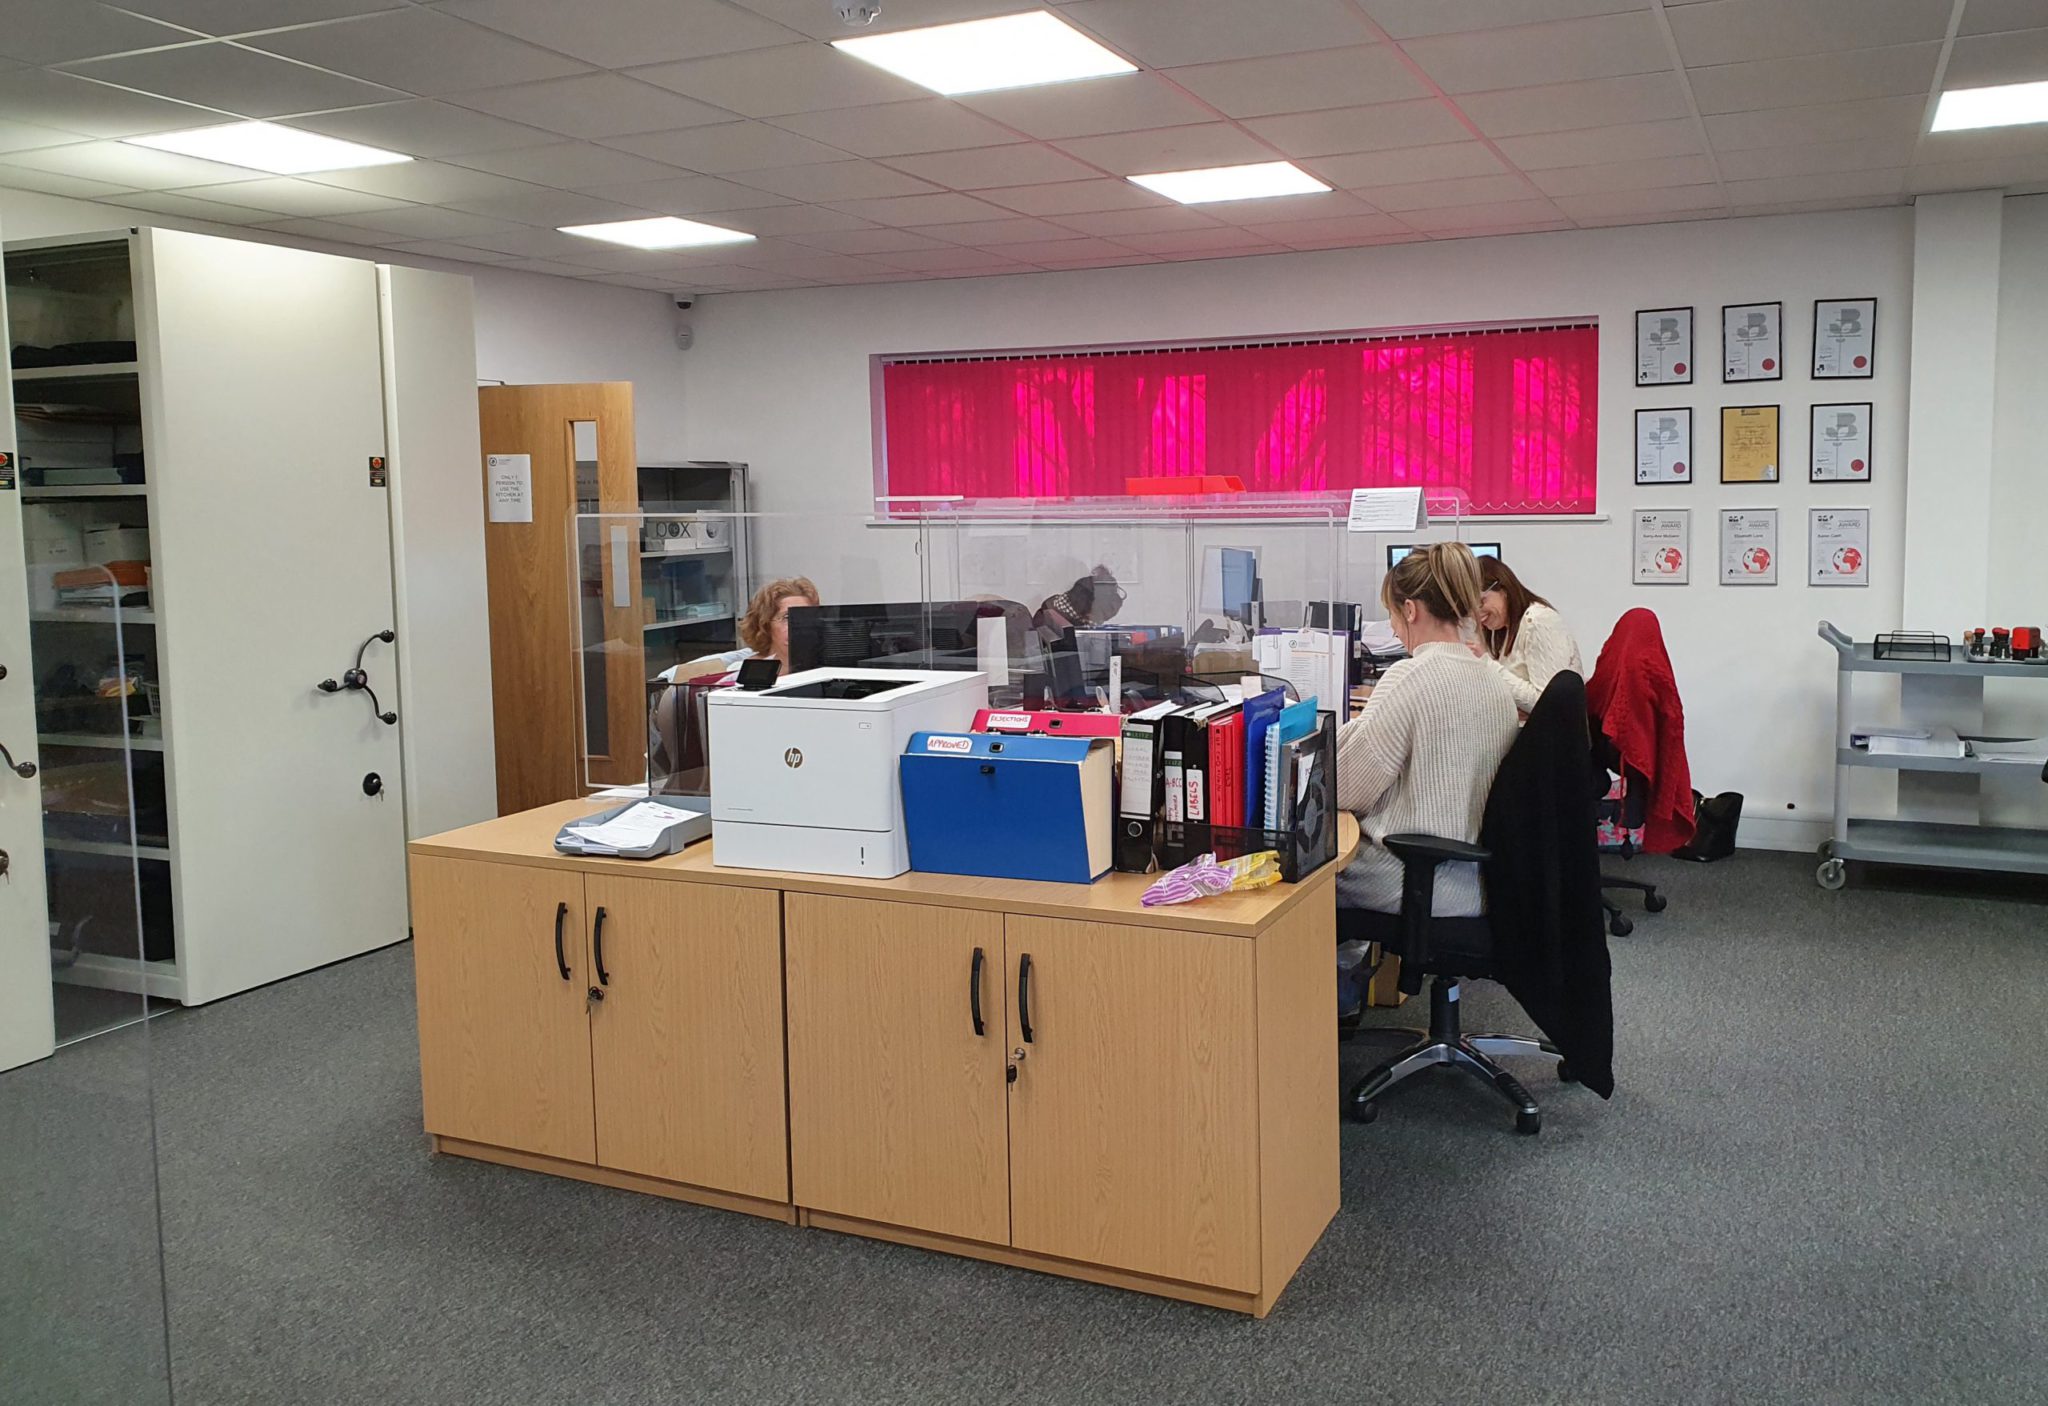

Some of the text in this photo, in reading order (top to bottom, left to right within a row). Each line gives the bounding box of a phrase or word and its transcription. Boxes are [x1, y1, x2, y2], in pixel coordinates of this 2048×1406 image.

[990, 715, 1028, 723] REJECTIONS
[928, 739, 969, 750] APPROVED
[1189, 780, 1200, 816] LABELS
